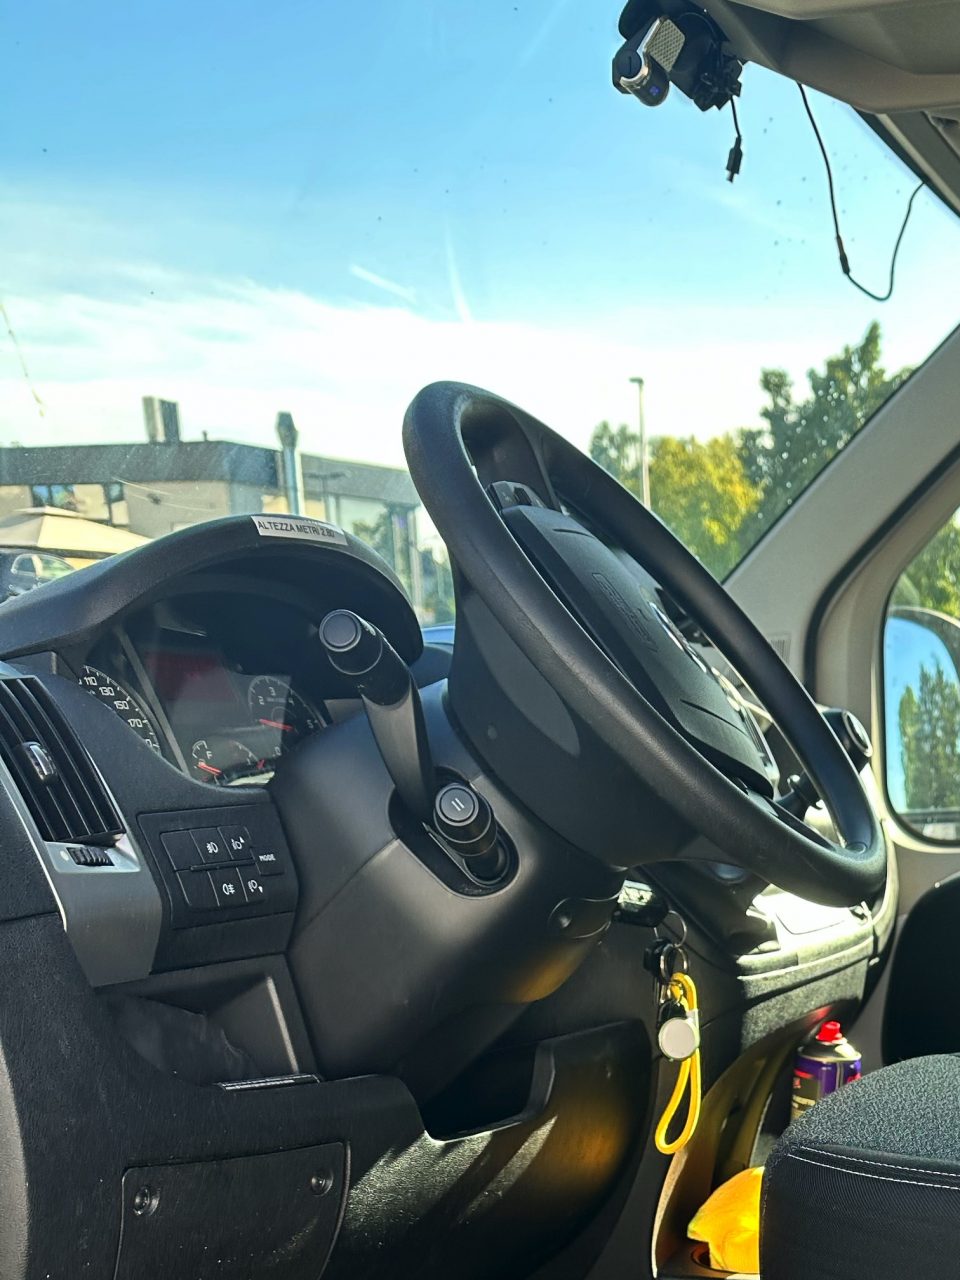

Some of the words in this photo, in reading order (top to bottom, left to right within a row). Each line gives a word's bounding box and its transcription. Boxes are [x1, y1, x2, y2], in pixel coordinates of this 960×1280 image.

[257, 520, 295, 532] ALTEZZA
[295, 524, 321, 536] METRI
[84, 676, 98, 686] 110
[99, 686, 115, 696] 130
[114, 700, 130, 710] 150
[257, 695, 265, 706] 2
[128, 718, 143, 728] 170
[205, 750, 213, 760] F
[259, 853, 276, 862] MODE
